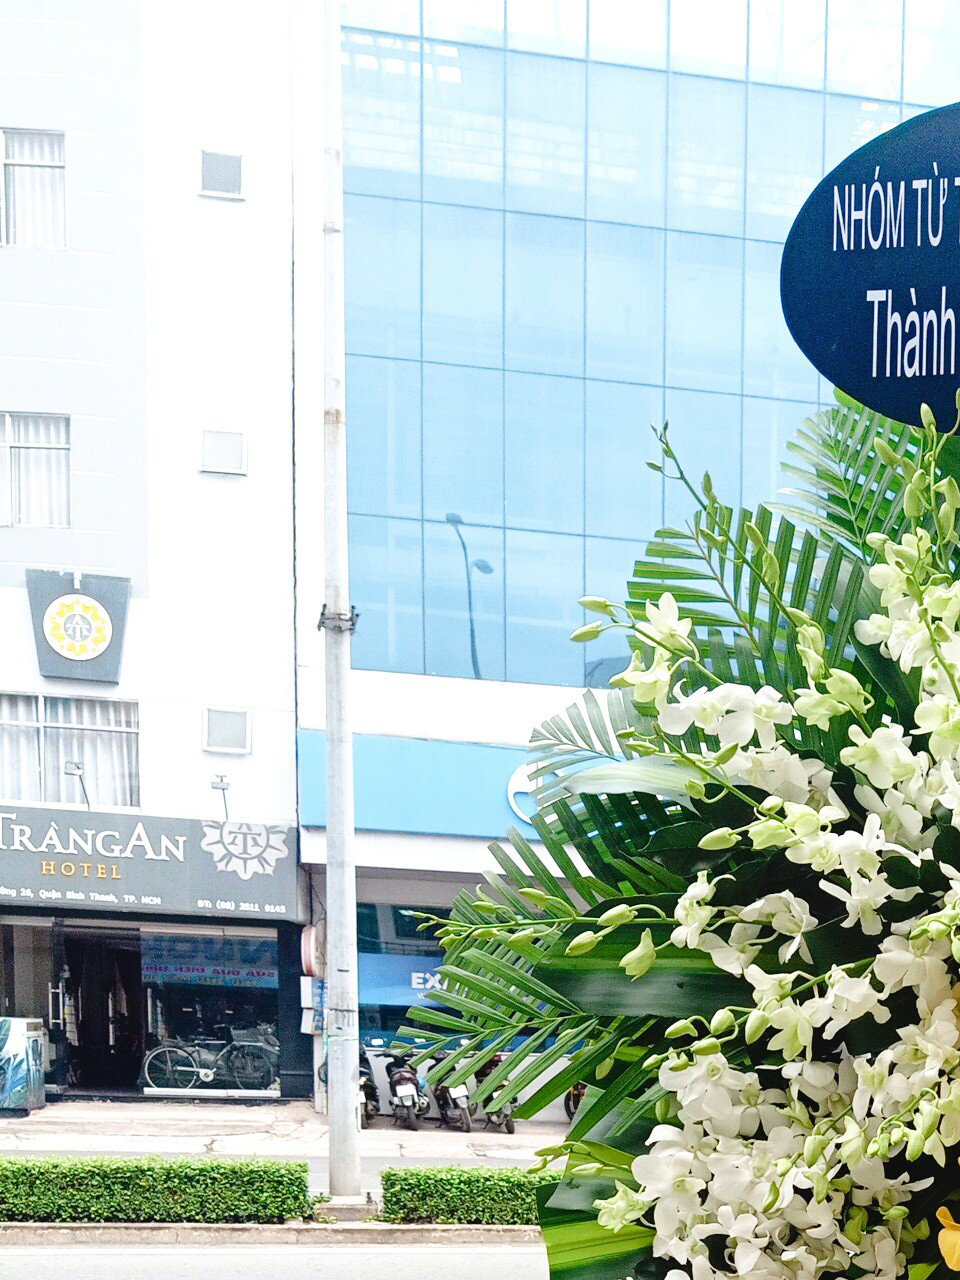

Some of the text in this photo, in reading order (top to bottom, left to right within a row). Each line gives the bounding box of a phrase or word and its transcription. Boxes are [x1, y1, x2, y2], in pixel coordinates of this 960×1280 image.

[833, 166, 904, 252] NHÓM
[912, 162, 948, 247] TỪ
[866, 286, 956, 378] Thành
[41, 860, 122, 880] HOTEL
[141, 896, 162, 905] HCM
